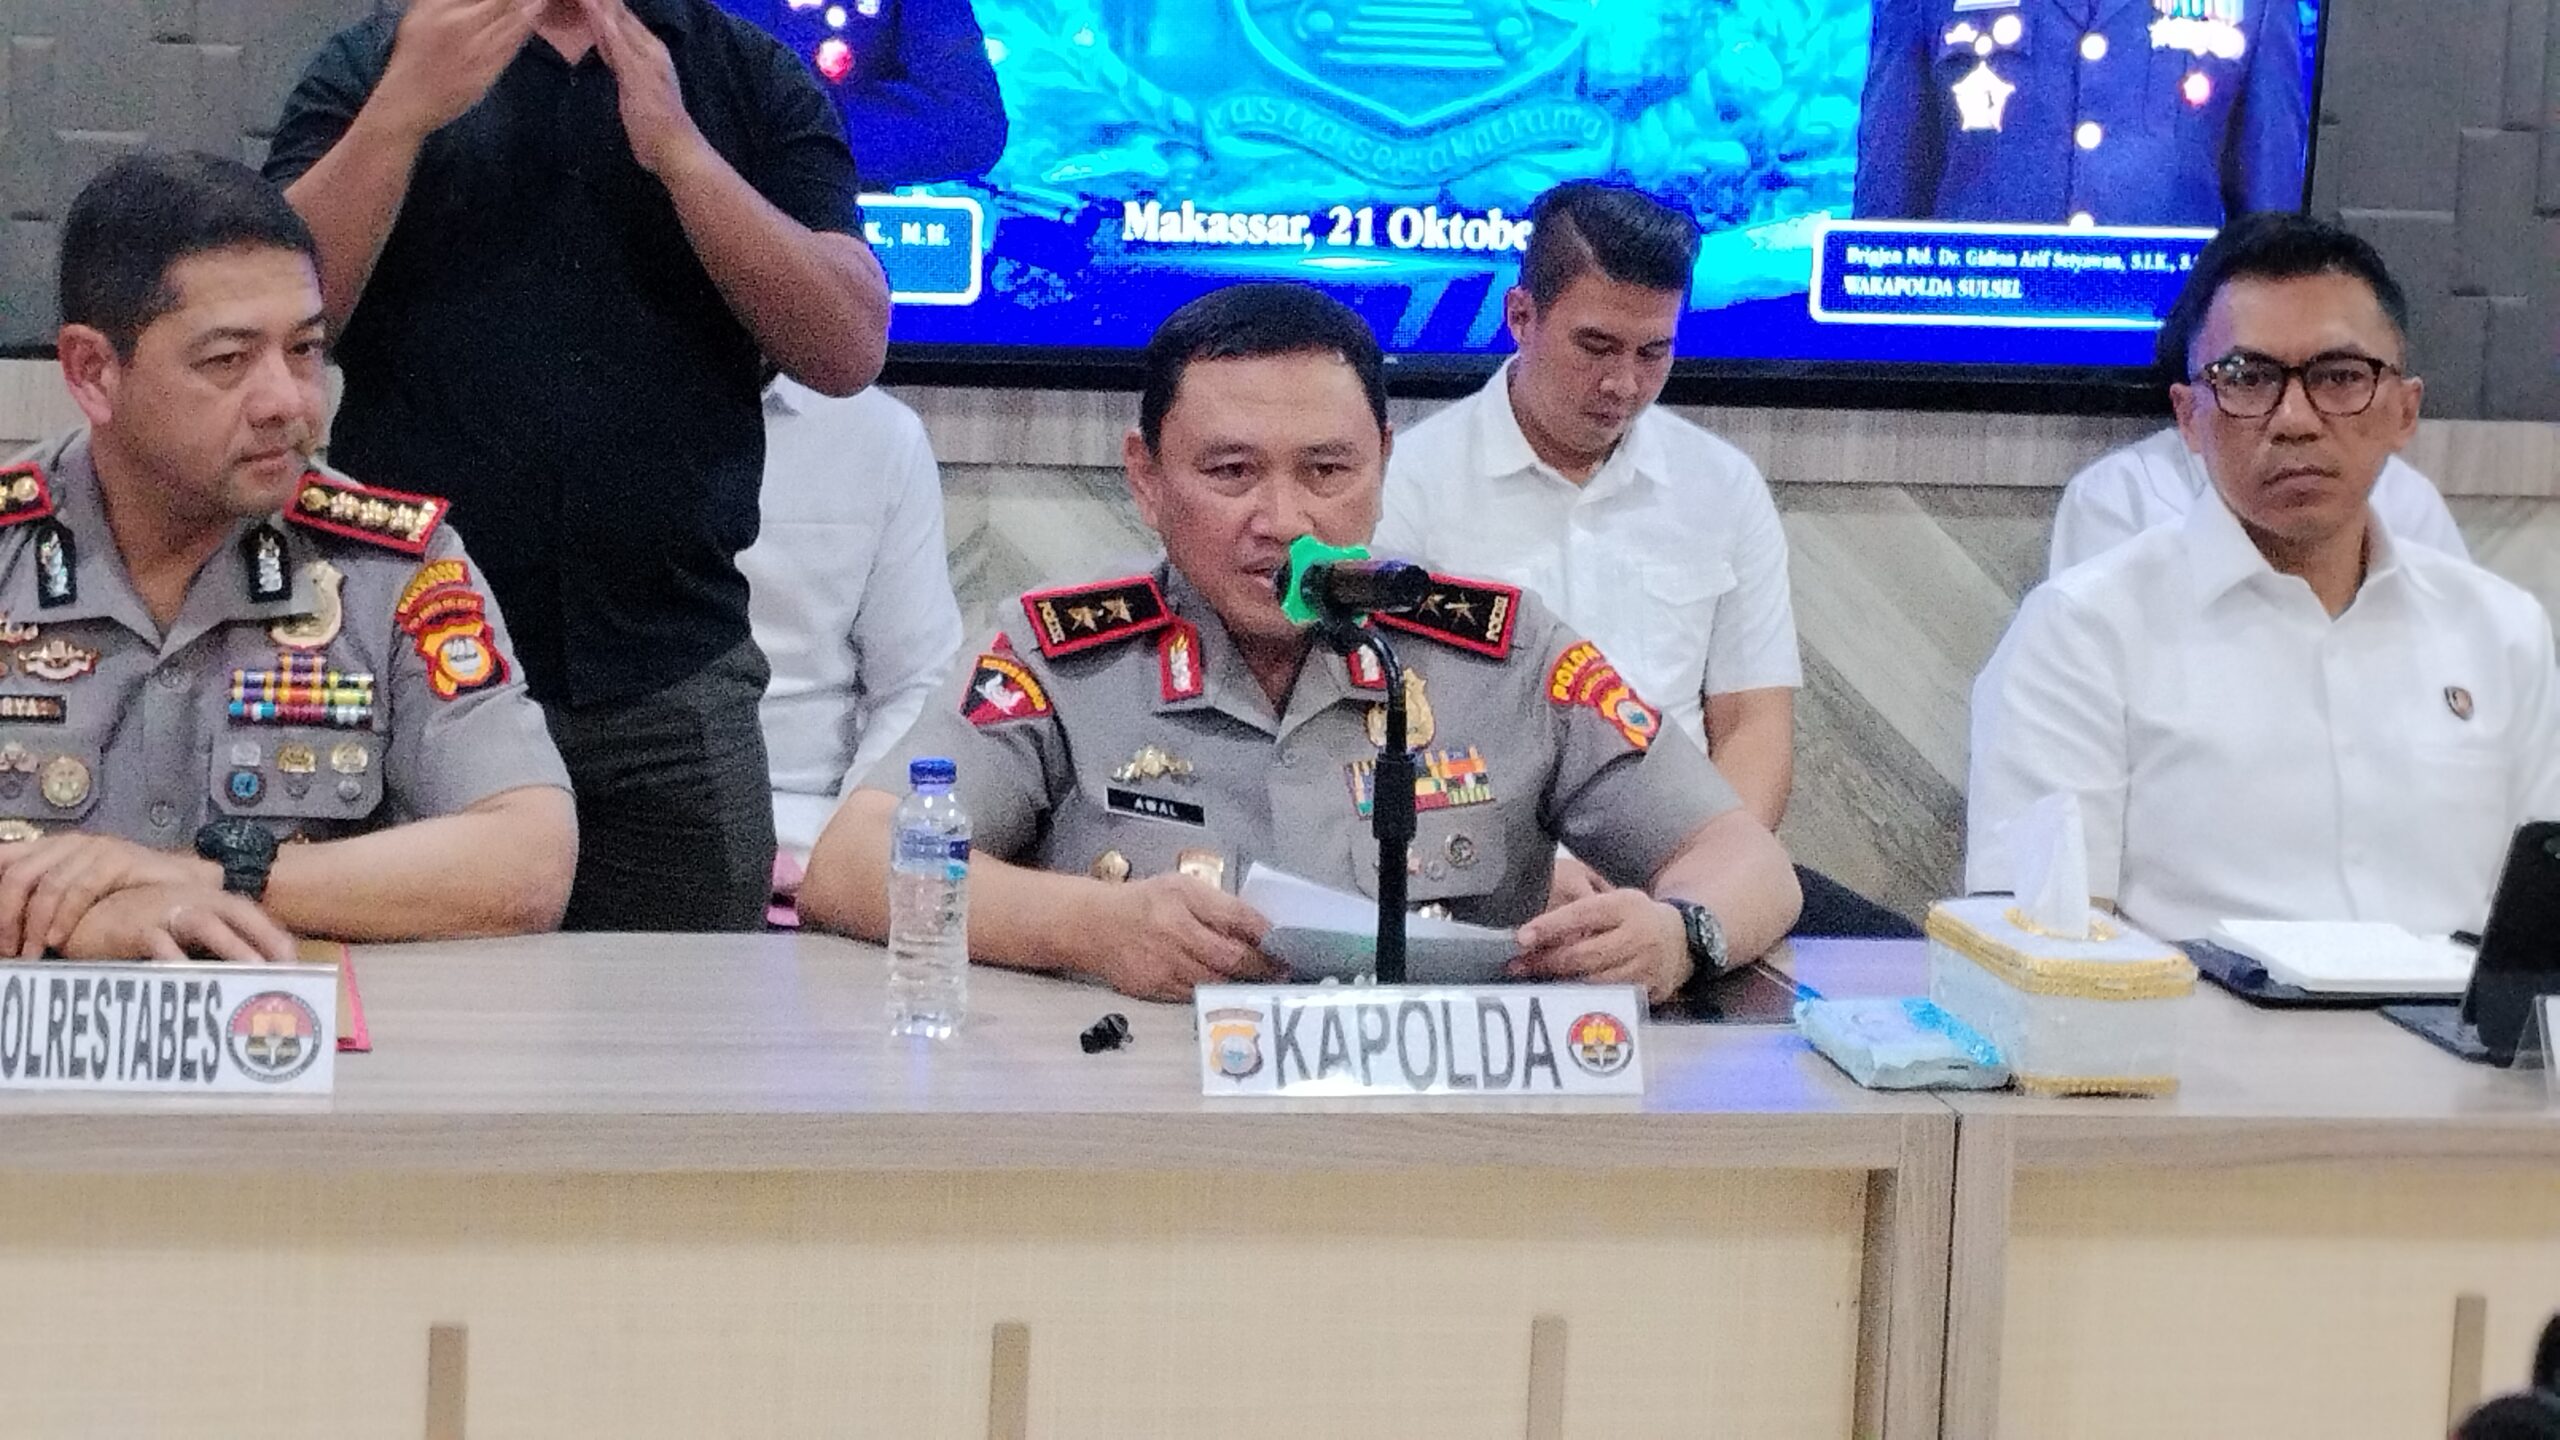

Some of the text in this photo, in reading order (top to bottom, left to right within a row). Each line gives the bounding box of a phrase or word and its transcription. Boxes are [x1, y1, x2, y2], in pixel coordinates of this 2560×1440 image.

[1122, 201, 1315, 252] Makassar,
[1327, 205, 1375, 246] 21
[1938, 247, 1961, 267] Dr.
[2019, 249, 2051, 268] Arif
[1843, 275, 2024, 299] WAKAPOLDA SULSEL
[1552, 643, 1600, 702] POLDA
[1270, 996, 1563, 1091] KAPOLDA
